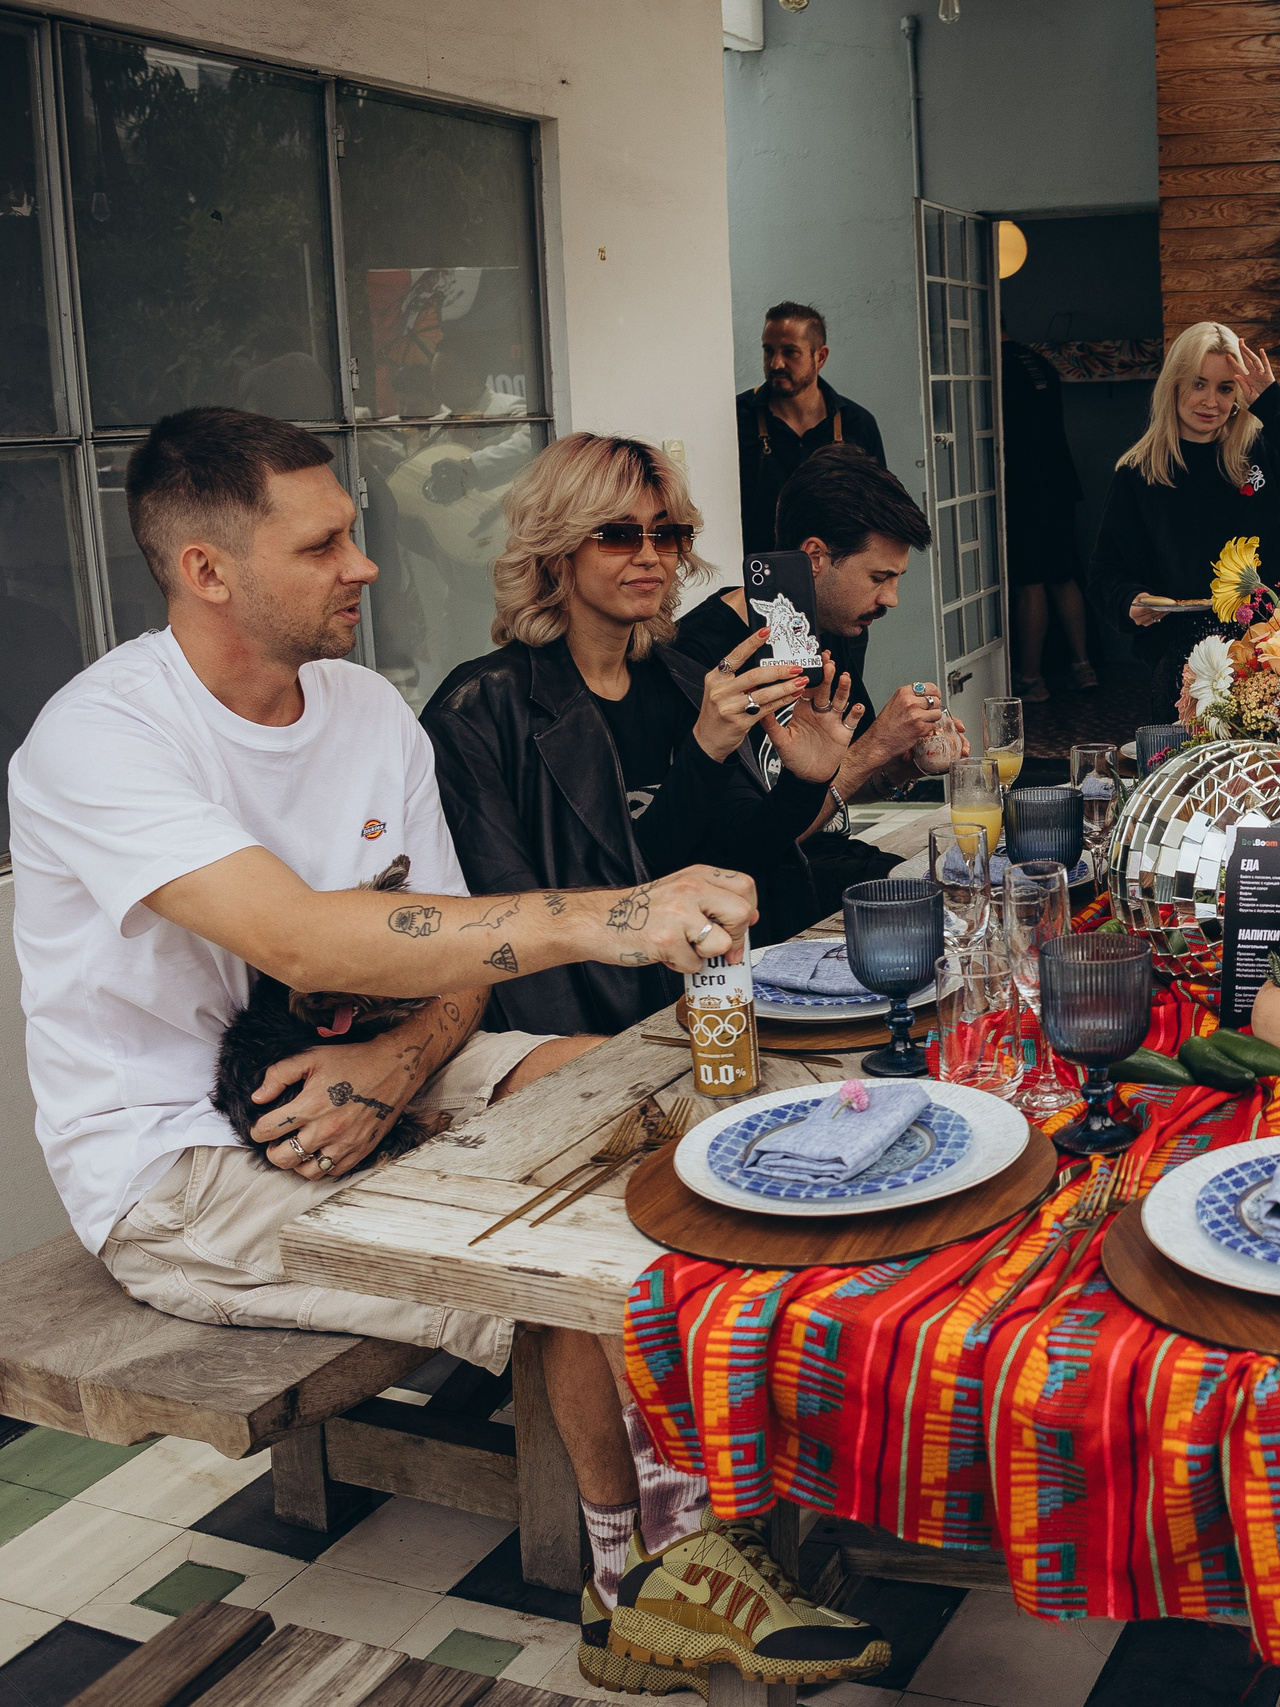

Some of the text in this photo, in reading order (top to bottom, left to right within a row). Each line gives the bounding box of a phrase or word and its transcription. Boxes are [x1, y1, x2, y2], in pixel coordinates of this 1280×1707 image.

[800, 658, 807, 667] IS
[1241, 838, 1278, 847] BetBoom
[1240, 858, 1259, 871] ЕДА
[1237, 928, 1280, 941] НАПИТКИ
[692, 972, 726, 988] Cero
